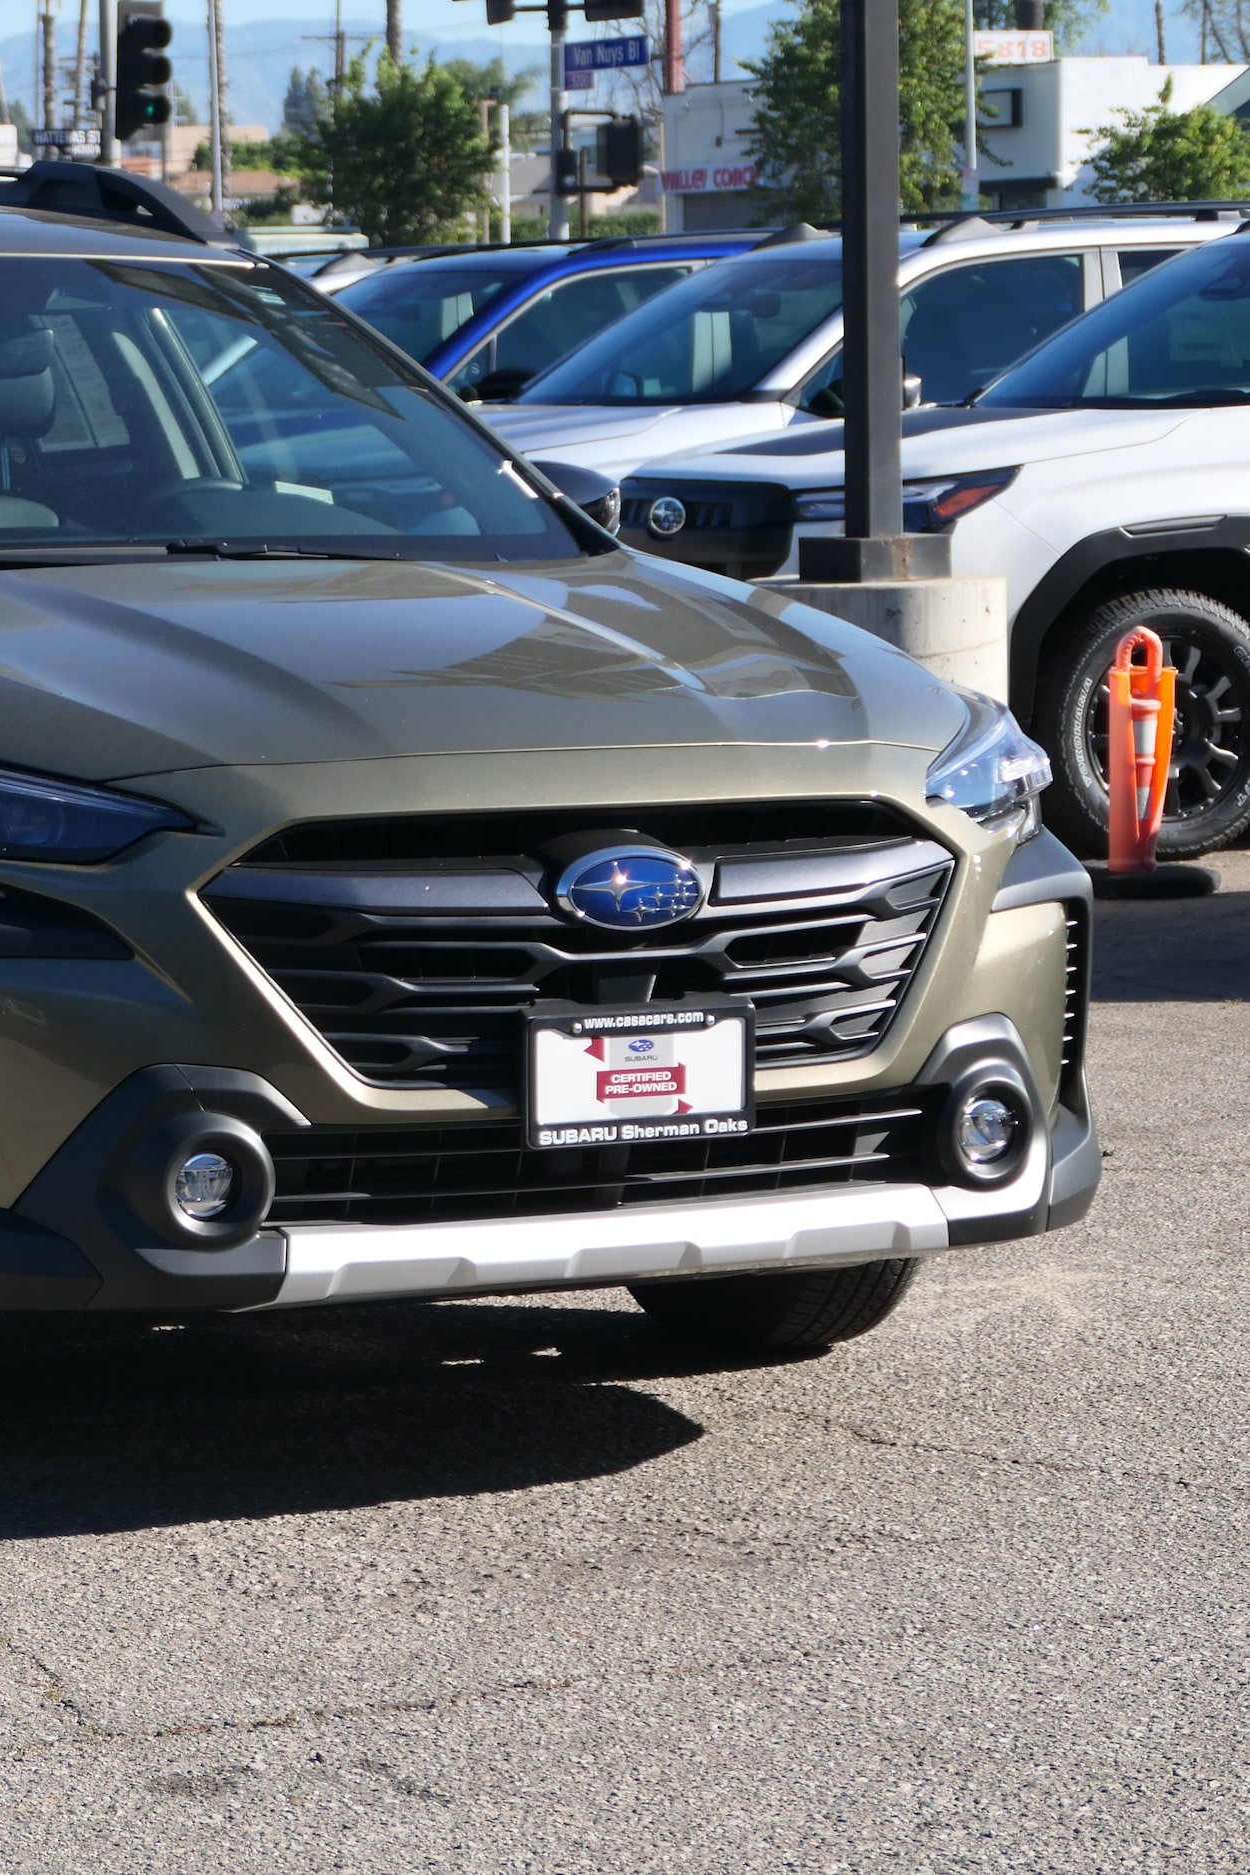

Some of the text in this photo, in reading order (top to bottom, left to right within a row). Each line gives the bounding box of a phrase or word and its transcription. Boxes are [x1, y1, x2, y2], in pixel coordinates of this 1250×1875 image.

[574, 40, 640, 67] Van Nuys Bl
[1073, 677, 1093, 788] YOKOHAMA
[584, 1011, 704, 1030] www.casacars.com
[625, 1054, 659, 1063] SUBARU
[611, 1070, 672, 1084] CERTIFIED
[605, 1082, 678, 1095] PRE-OWNED
[539, 1118, 748, 1146] SUBARU Sherman Oaks
